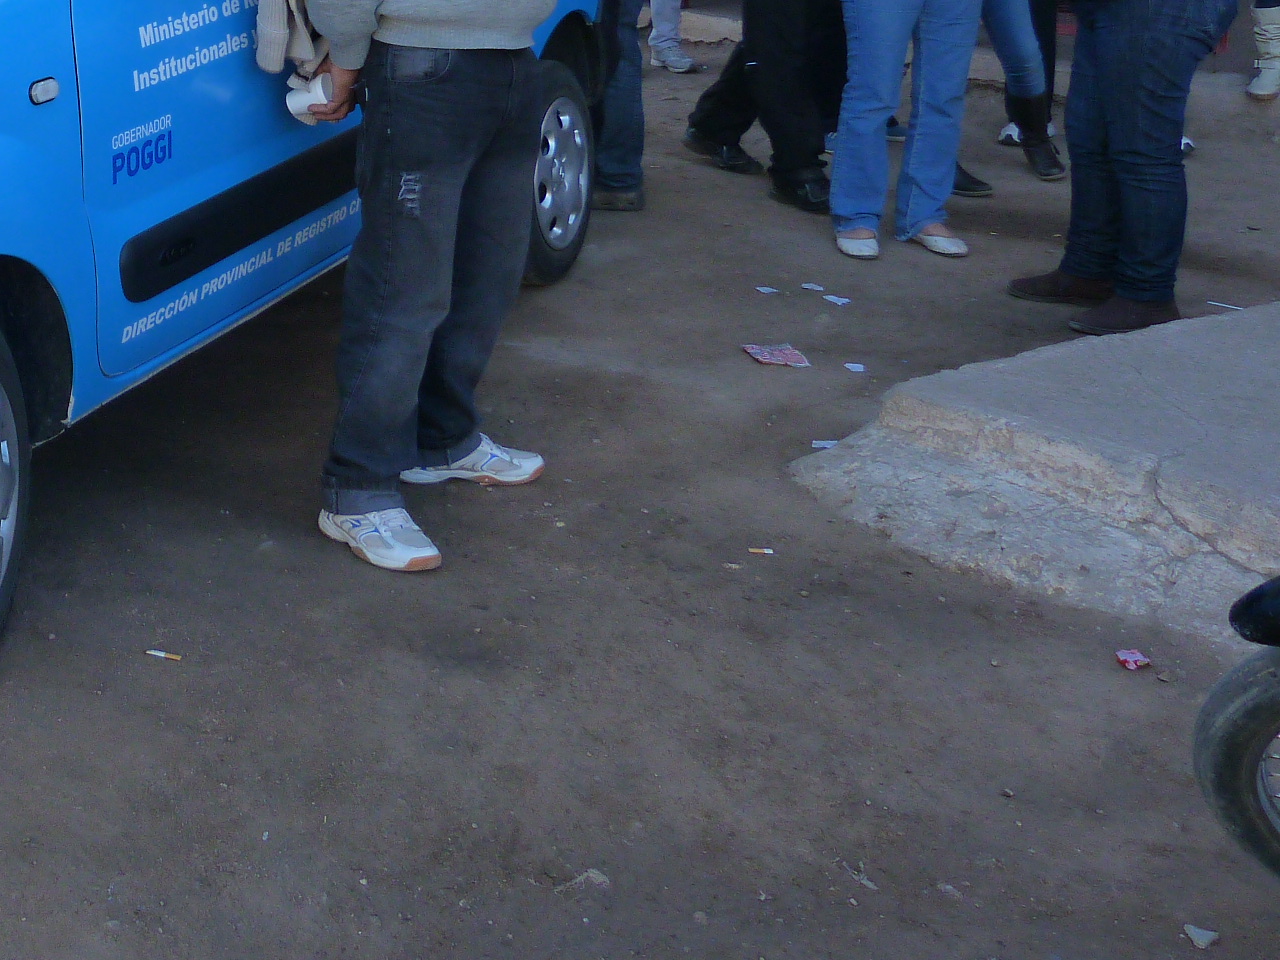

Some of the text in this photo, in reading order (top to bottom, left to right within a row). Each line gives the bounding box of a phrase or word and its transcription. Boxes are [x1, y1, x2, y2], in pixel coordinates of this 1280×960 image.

[138, 3, 219, 48] Ministerio
[133, 33, 248, 92] Institucionales
[111, 114, 172, 150] GOBERNADOR
[111, 130, 173, 185] POGGI
[121, 288, 198, 344] DIRECCIÓN
[200, 247, 274, 300] PROVINCIAL
[276, 234, 293, 257] DE
[293, 206, 347, 248] REGISTRO
[349, 197, 361, 215] CI
